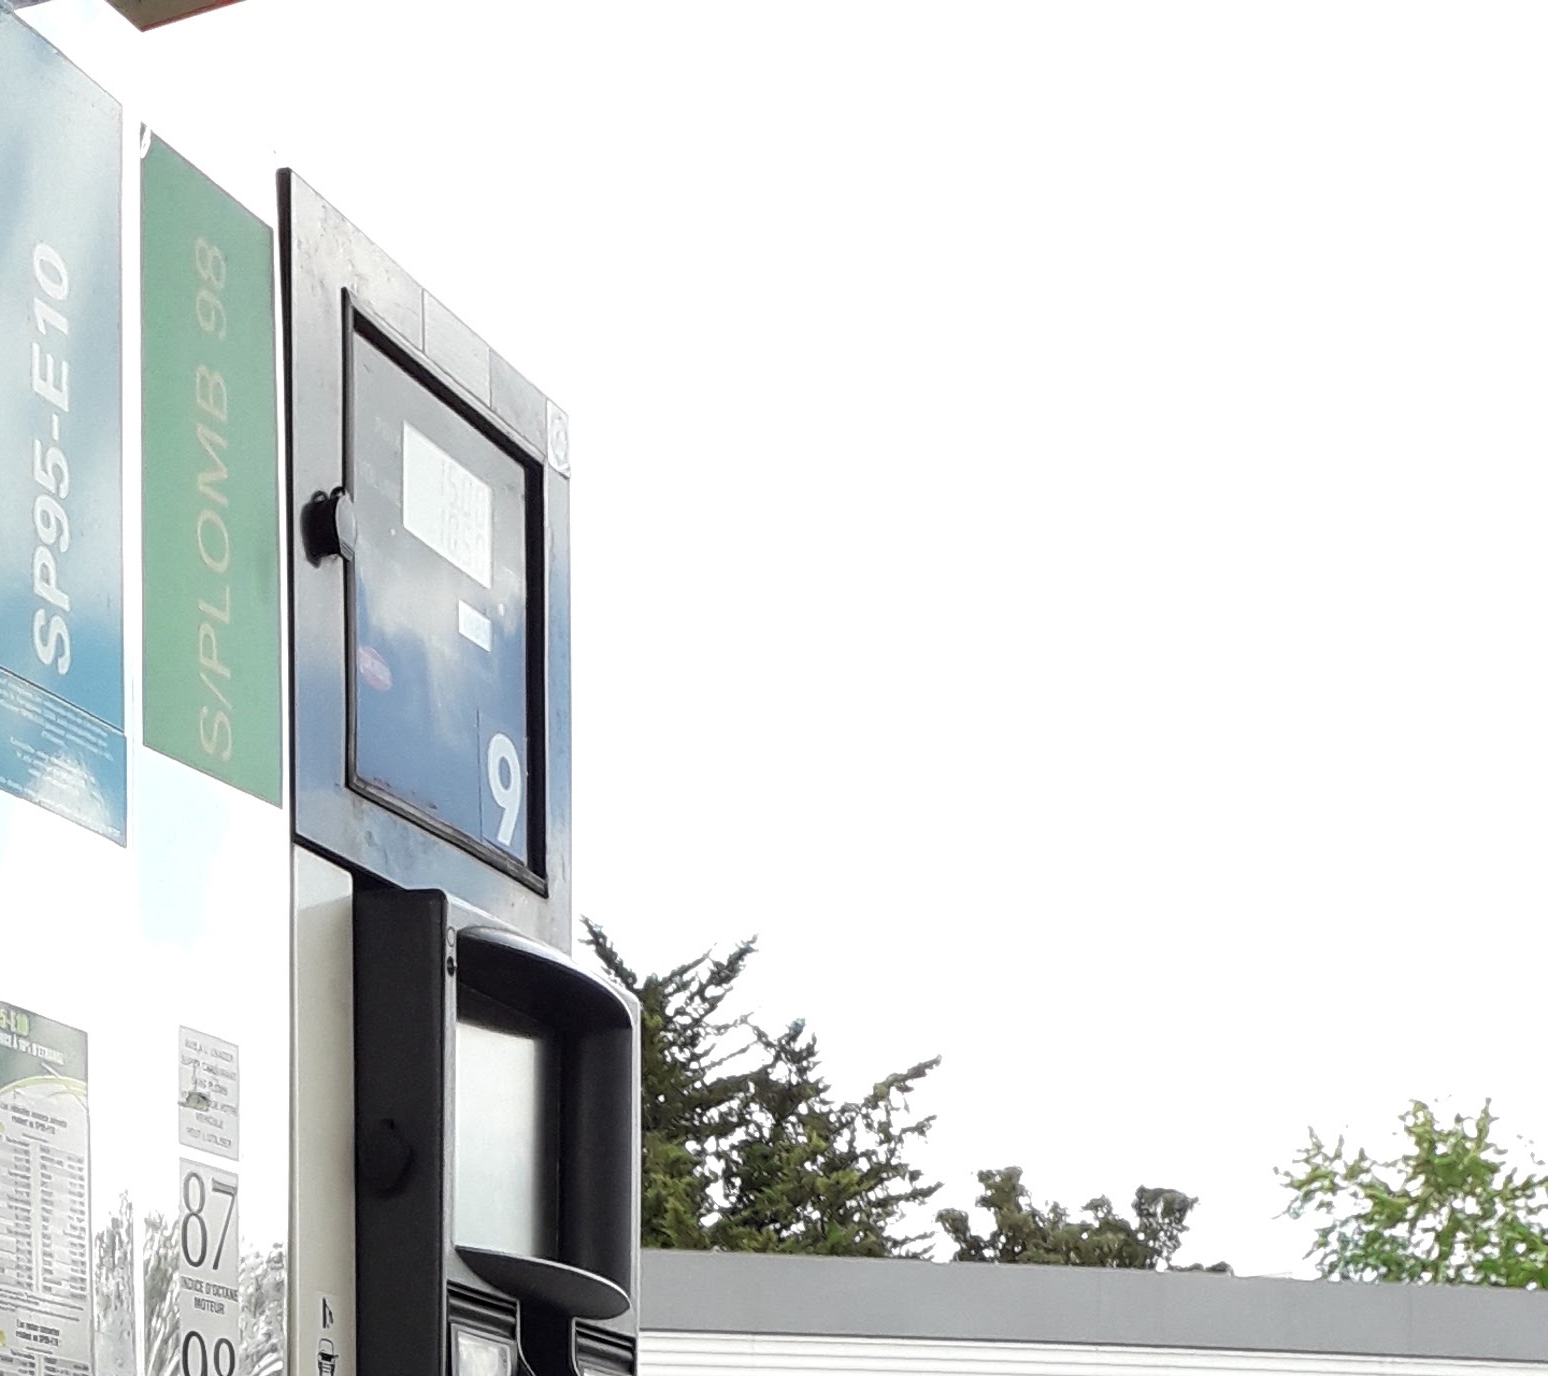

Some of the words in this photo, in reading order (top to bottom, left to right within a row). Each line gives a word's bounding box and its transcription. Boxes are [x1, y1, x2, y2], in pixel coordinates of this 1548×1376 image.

[195, 236, 228, 342] 98
[33, 242, 72, 677] SP95-E10
[487, 732, 523, 847] 9
[181, 1171, 237, 1270] 87
[194, 1296, 225, 1315] MOTEUR
